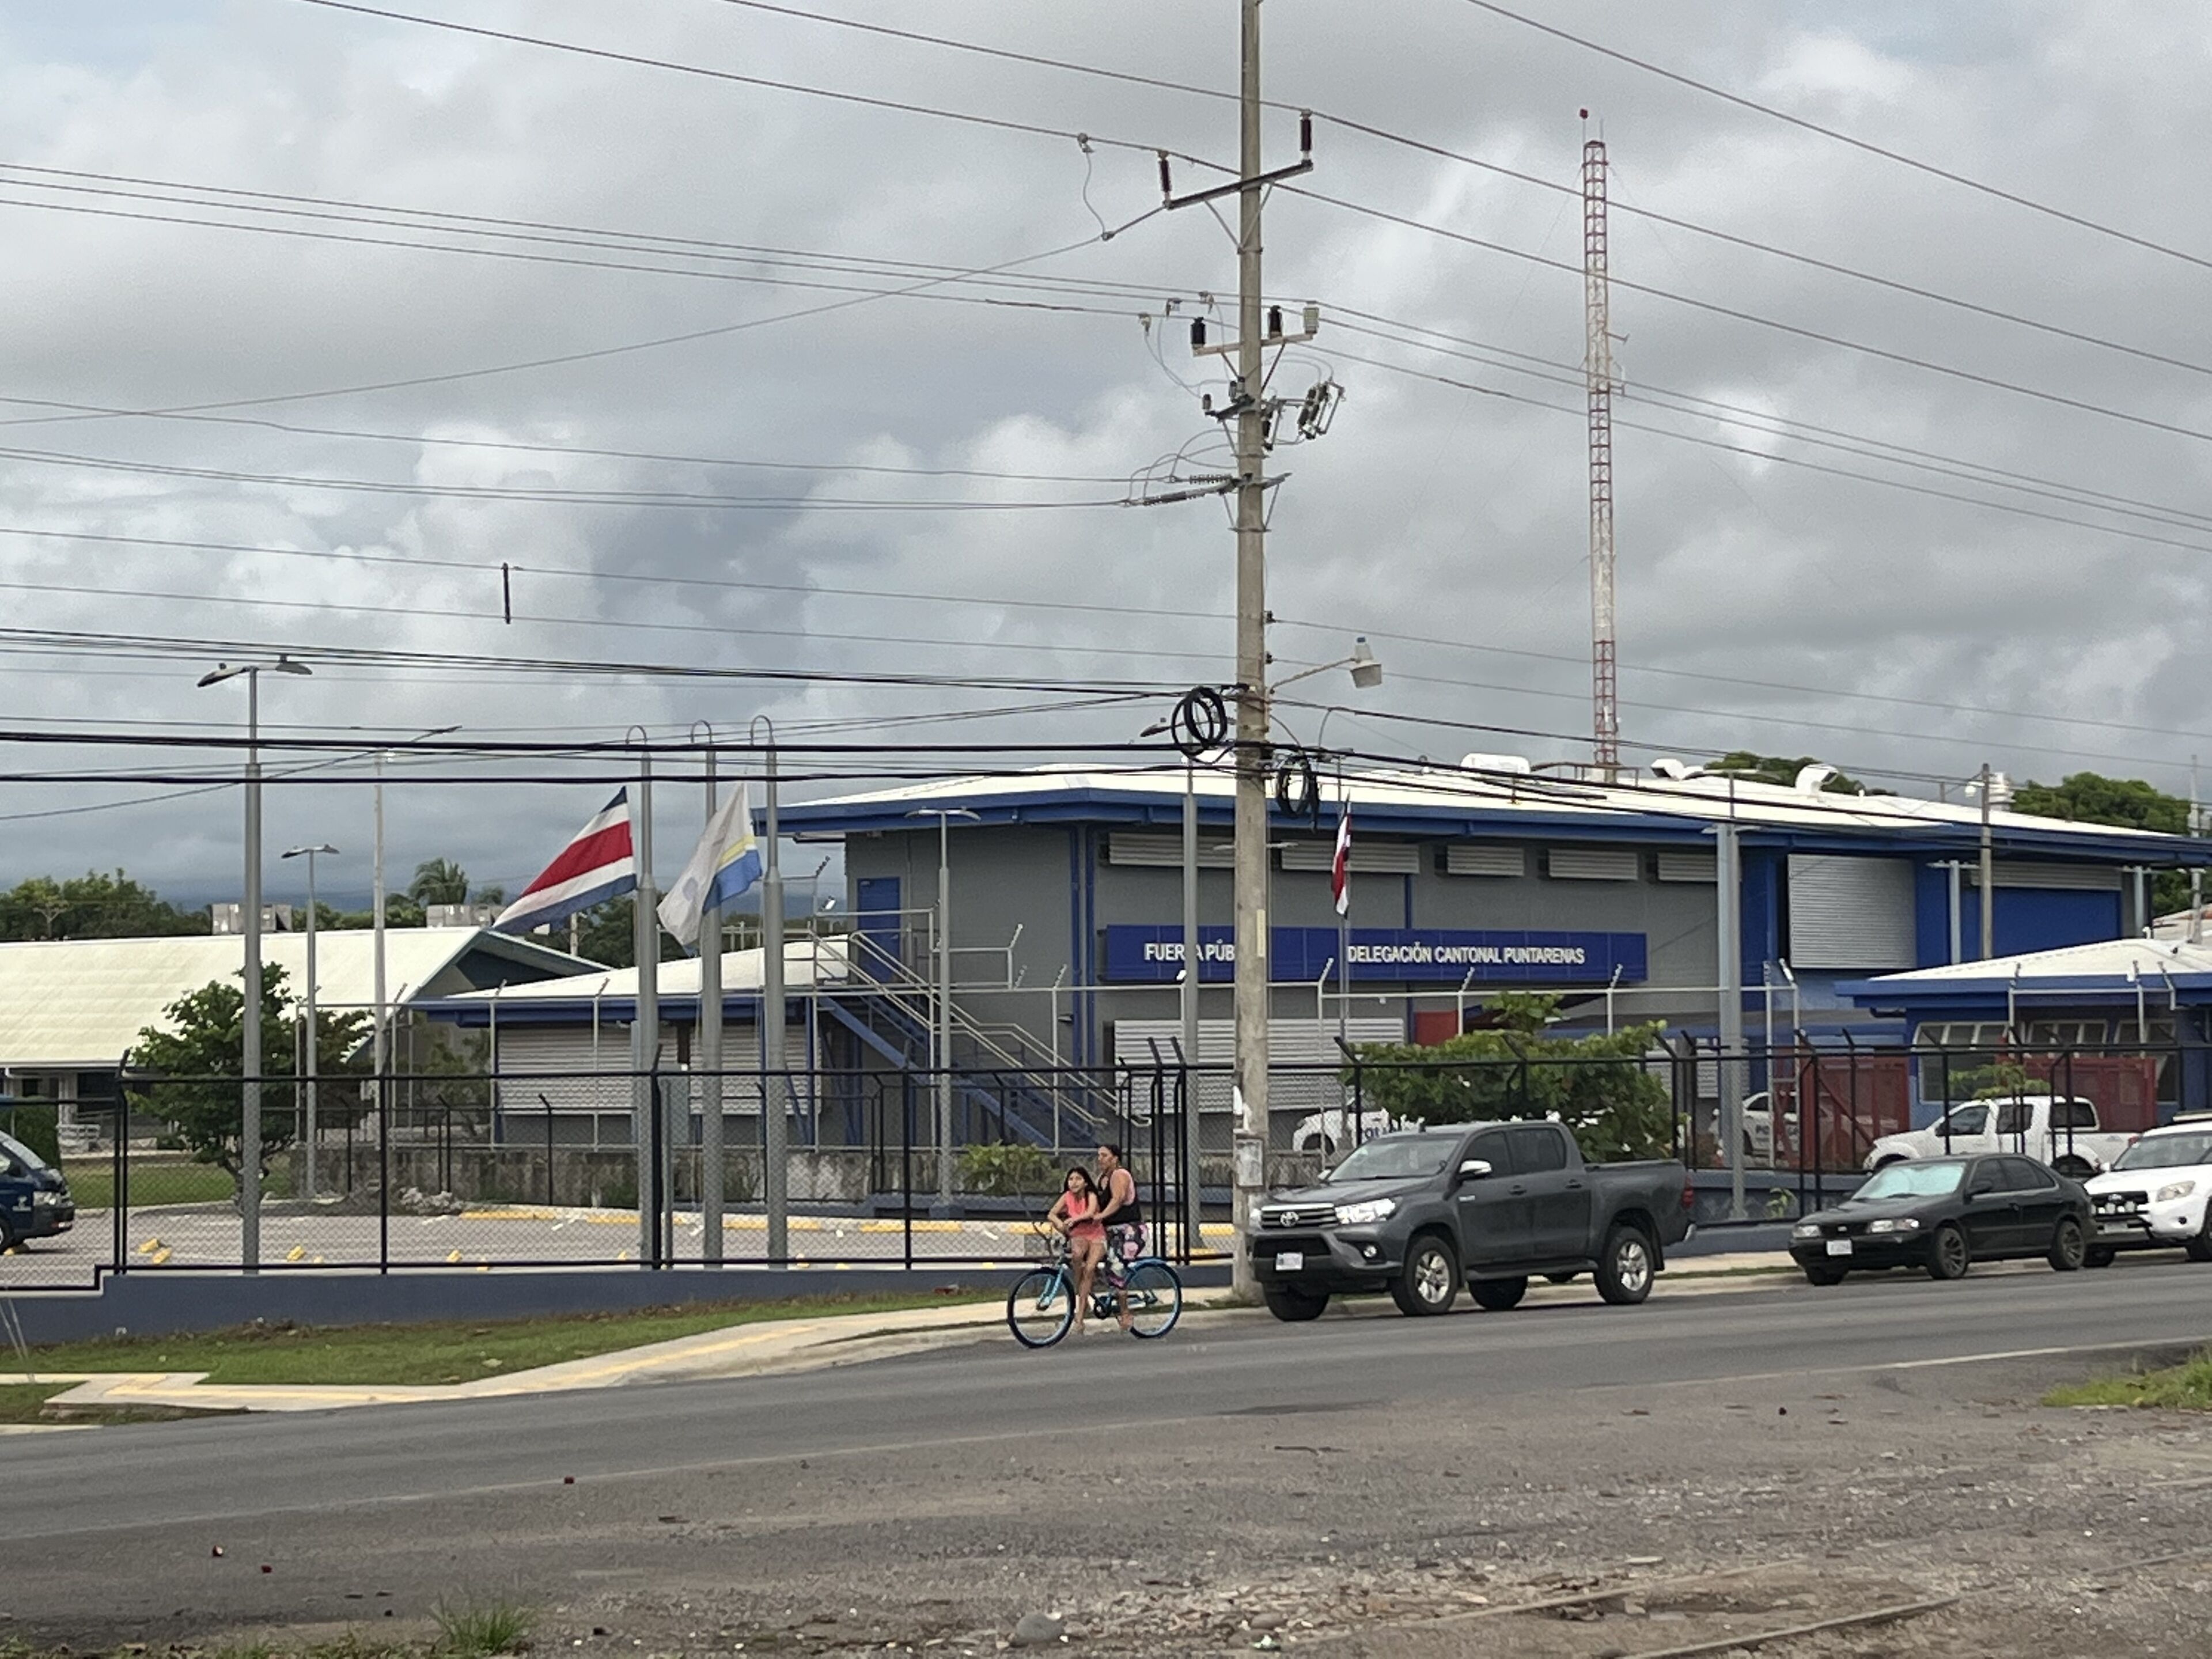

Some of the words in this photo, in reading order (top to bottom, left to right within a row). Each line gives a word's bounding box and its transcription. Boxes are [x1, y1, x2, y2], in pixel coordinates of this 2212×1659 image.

[1144, 942, 1204, 961] FUERA
[1348, 941, 1432, 963] DELEGACIÓN
[1434, 946, 1502, 963] CANTONAL
[1503, 947, 1585, 964] PUNTARENAS
